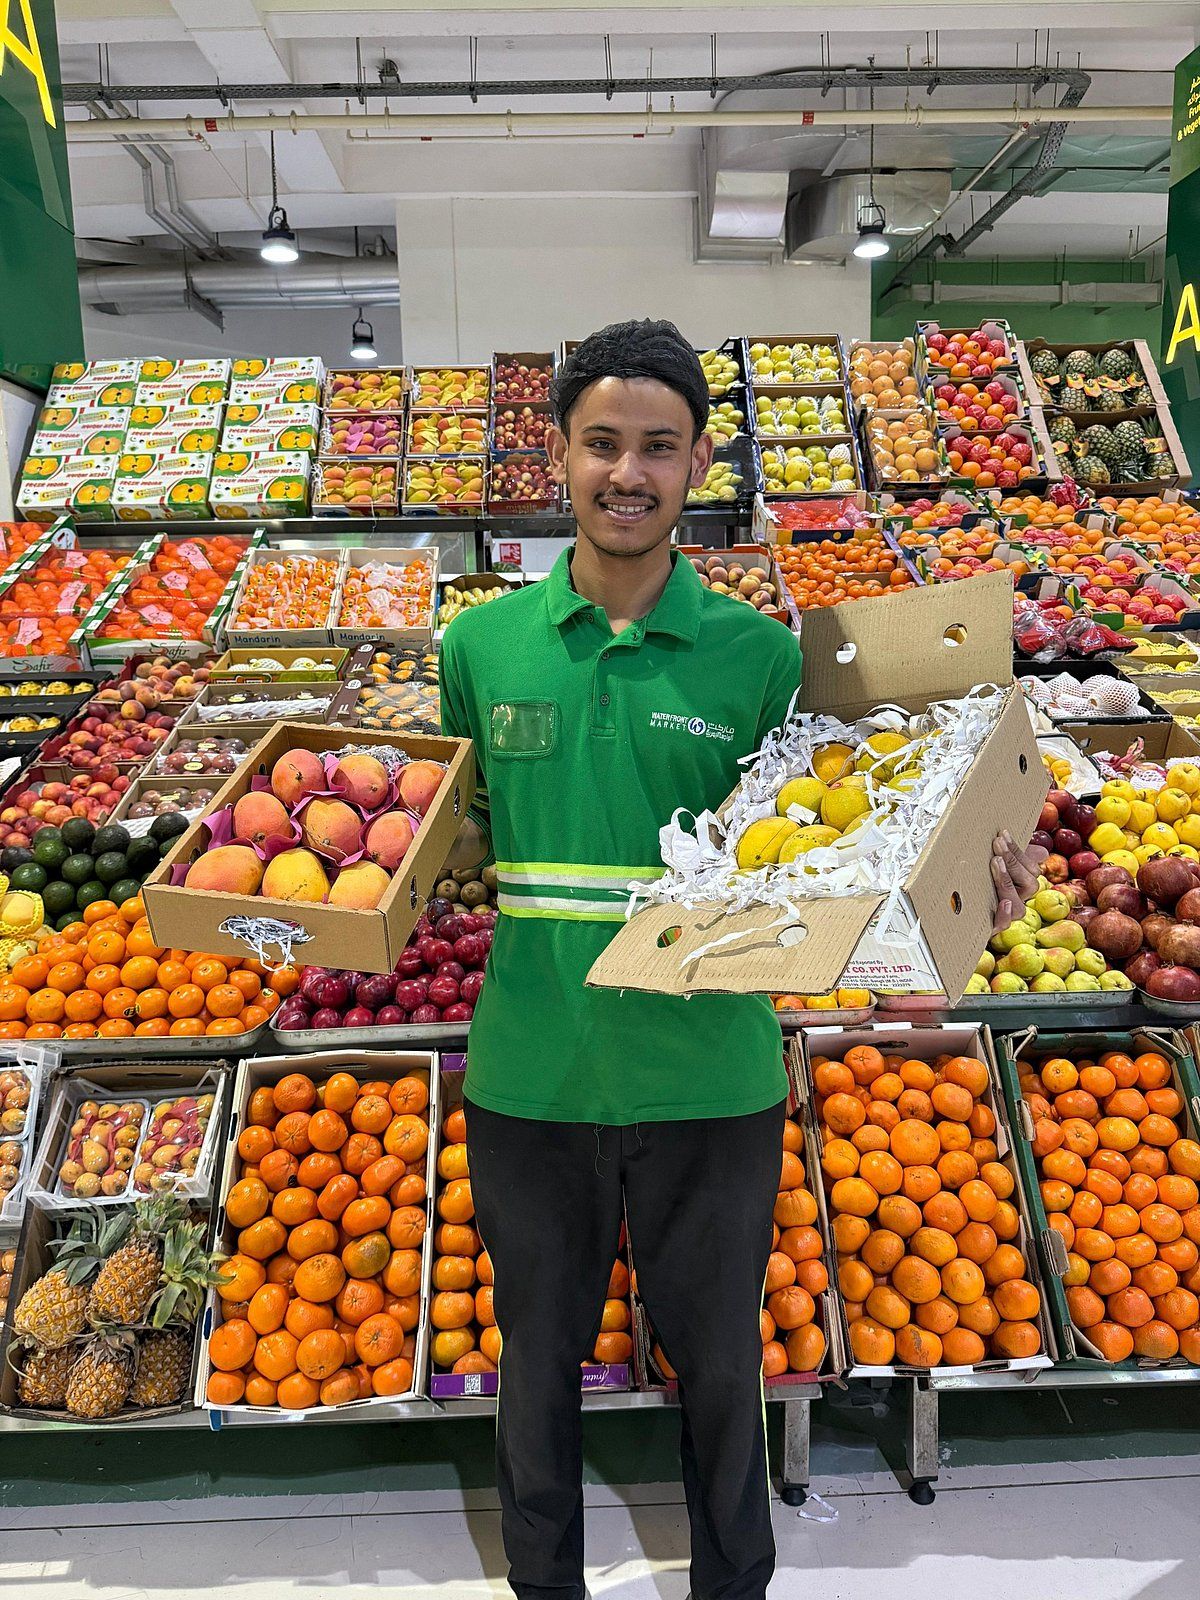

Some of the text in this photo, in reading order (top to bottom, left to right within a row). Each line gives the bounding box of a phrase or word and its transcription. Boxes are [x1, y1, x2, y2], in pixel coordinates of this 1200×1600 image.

[234, 636, 281, 644] Mandarin
[340, 633, 386, 641] Mandarin
[652, 712, 688, 723] WATERFRONT
[650, 720, 687, 731] MARKET
[892, 965, 916, 973] LTD.
